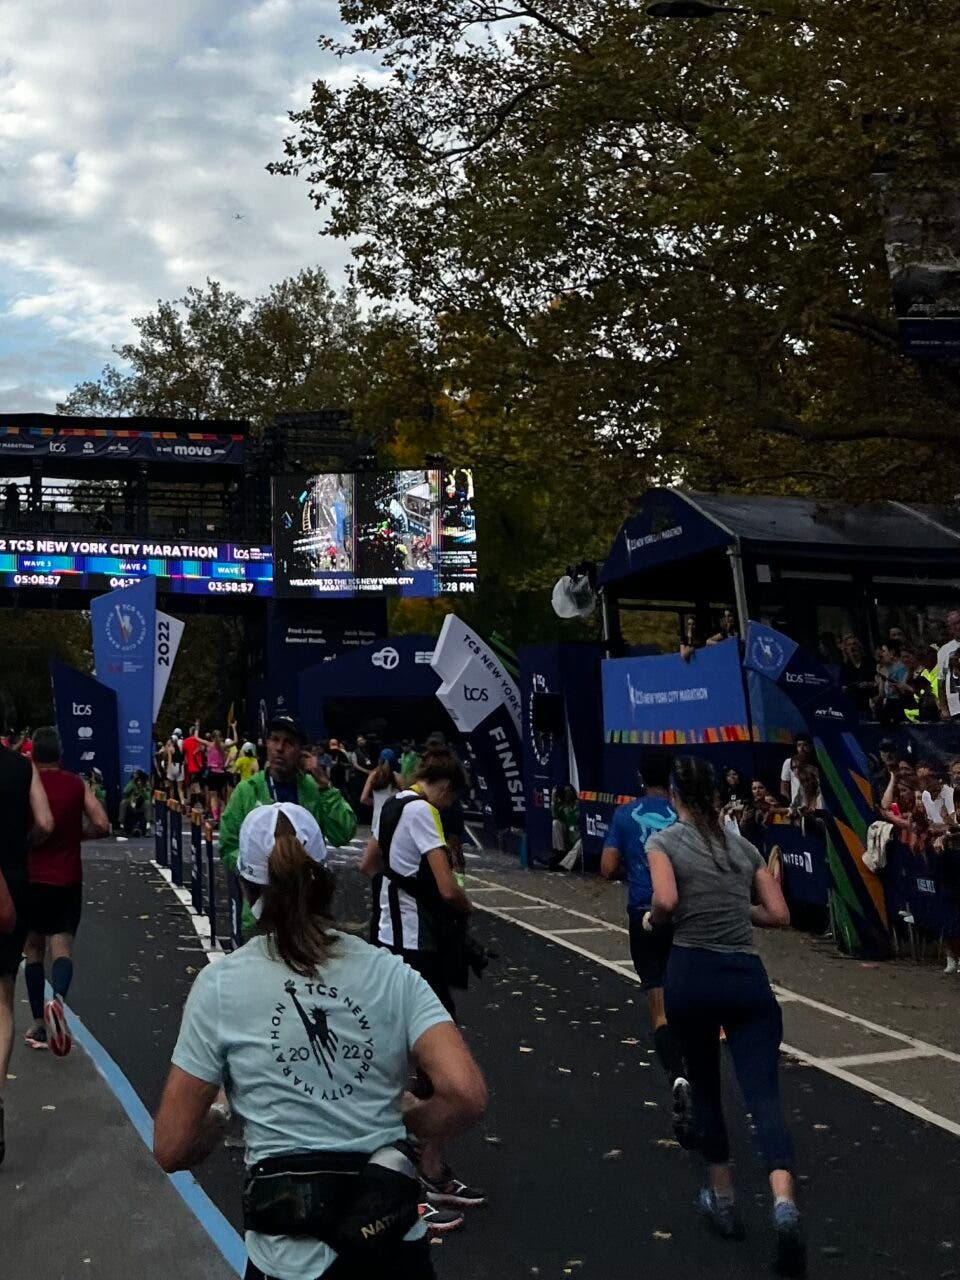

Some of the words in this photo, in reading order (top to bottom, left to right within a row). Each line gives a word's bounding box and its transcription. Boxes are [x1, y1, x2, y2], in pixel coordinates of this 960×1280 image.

[49, 441, 67, 453] tcs
[174, 445, 212, 456] move
[9, 540, 35, 552] TCS
[36, 541, 69, 553] NEW
[71, 542, 107, 554] YORK
[110, 543, 140, 556] CITY
[142, 545, 218, 559] MARATHON
[233, 547, 249, 560] tcs
[23, 560, 46, 568] WAVE
[119, 563, 140, 571] WAVE
[142, 563, 147, 571] 4
[218, 567, 239, 575] WAVE
[14, 574, 61, 586] 05:08:57
[290, 579, 323, 587] WELCOME
[362, 578, 378, 586] NEW
[379, 578, 398, 586] YORK
[399, 577, 414, 585] CITY
[208, 581, 254, 593] 03:58:57
[460, 582, 474, 593] PM
[158, 622, 170, 667] 2022
[463, 634, 480, 655] TCS
[481, 654, 502, 680] NEW
[502, 679, 521, 711] YORK
[786, 672, 804, 684] tcs
[464, 684, 489, 701] tcs
[72, 702, 92, 715] tcs
[488, 726, 527, 812] FINISH
[305, 983, 338, 998] TCS
[343, 997, 370, 1030] NEW
[270, 1003, 315, 1095] MARATHON
[290, 1047, 310, 1062] 20
[342, 1045, 361, 1059] 22
[354, 1038, 374, 1083] YORK
[322, 1083, 353, 1100] CITY
